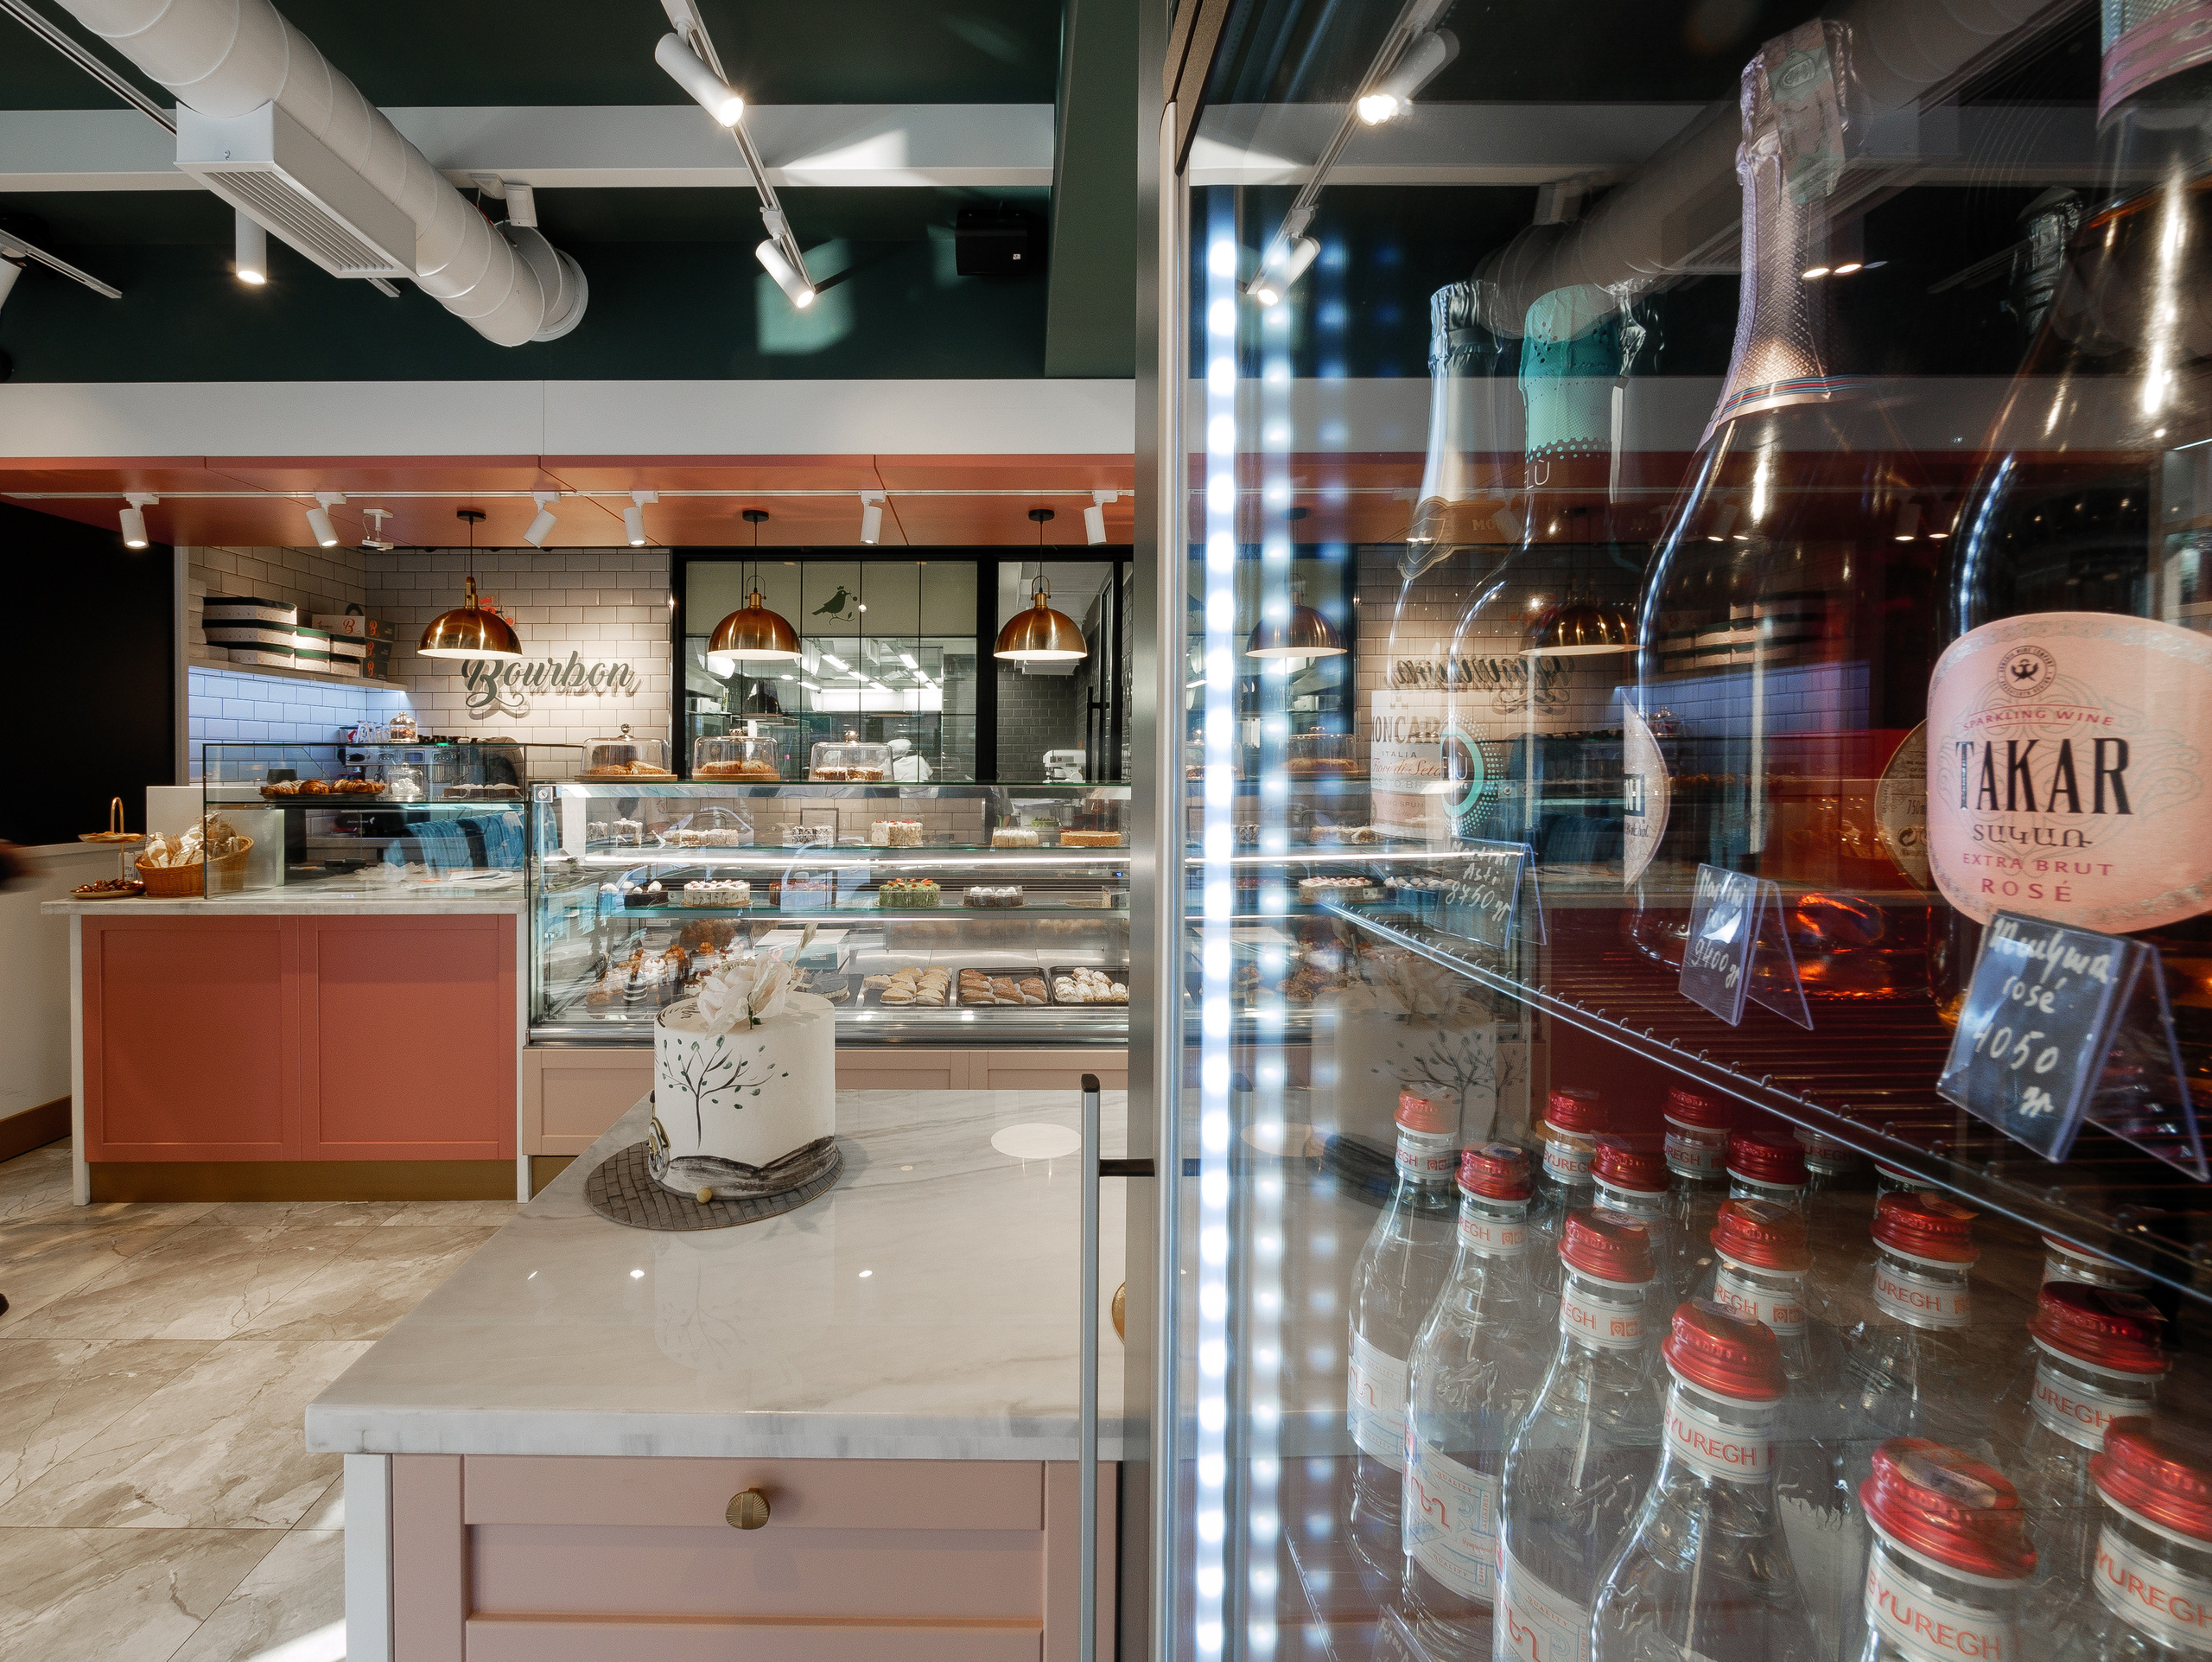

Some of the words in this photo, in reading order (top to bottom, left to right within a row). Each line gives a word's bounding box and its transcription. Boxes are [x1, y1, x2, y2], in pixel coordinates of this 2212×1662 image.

[461, 650, 636, 708] Bourbon
[1963, 710, 2047, 731] SPARKLING
[2056, 710, 2115, 727] WINE
[1394, 759, 1408, 776] di
[1955, 736, 2134, 815] TAKAR
[1463, 863, 1499, 886] Asti
[1963, 852, 2024, 869] EXTRA
[2036, 859, 2113, 876] BRUT
[1981, 878, 2072, 902] ROSÉ
[2002, 975, 2068, 1014] rosé
[1437, 1471, 1472, 1493] QUALITY
[1433, 1553, 1468, 1577] QUALITY
[1528, 1595, 1568, 1627] QUALITY
